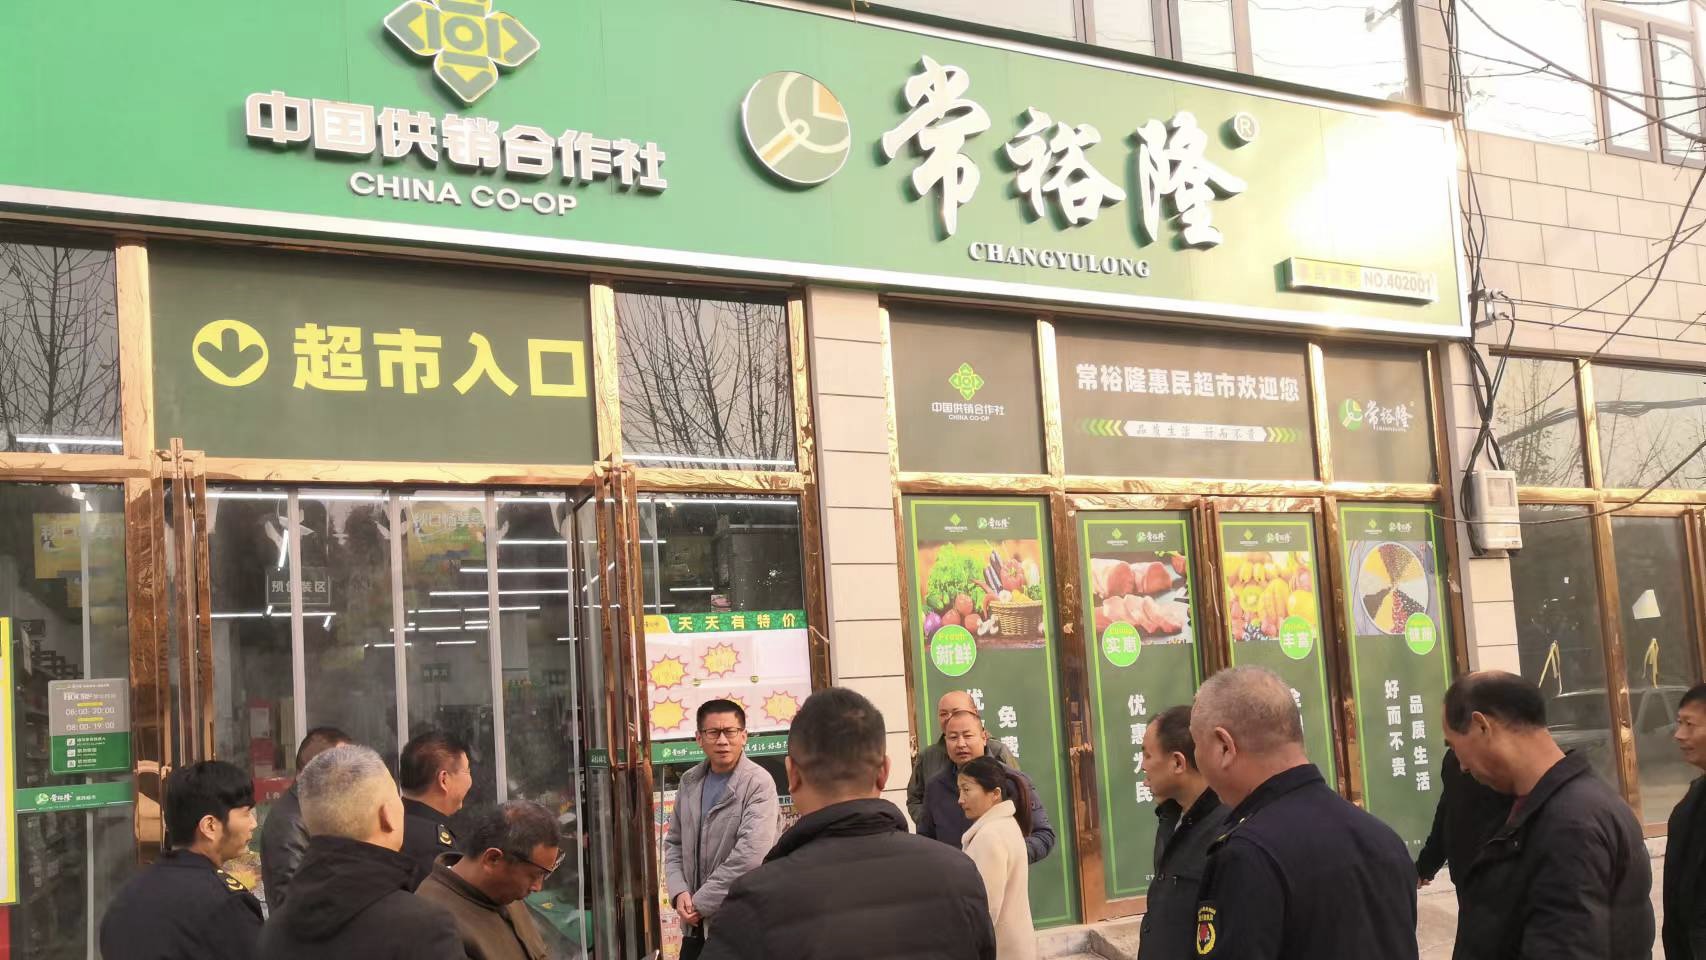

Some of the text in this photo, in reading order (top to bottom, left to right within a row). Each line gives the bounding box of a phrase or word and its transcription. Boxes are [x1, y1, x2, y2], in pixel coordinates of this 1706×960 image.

[245, 90, 668, 196] 中国供销合作社
[881, 55, 1247, 246] 常裕隆
[350, 171, 578, 217] CHINA CO-OP
[968, 241, 1150, 278] CHANGYULONG
[292, 322, 588, 398] 超市入口
[1076, 363, 1300, 402] 常裕隆惠民超市欢迎您
[931, 402, 1005, 416] 中国供销合作社
[678, 612, 796, 631] 天天有特价
[936, 644, 973, 665] 新鲜
[1105, 636, 1137, 653] 实惠
[1384, 679, 1406, 777] 好而不贵
[1409, 694, 1430, 791] 品质生活
